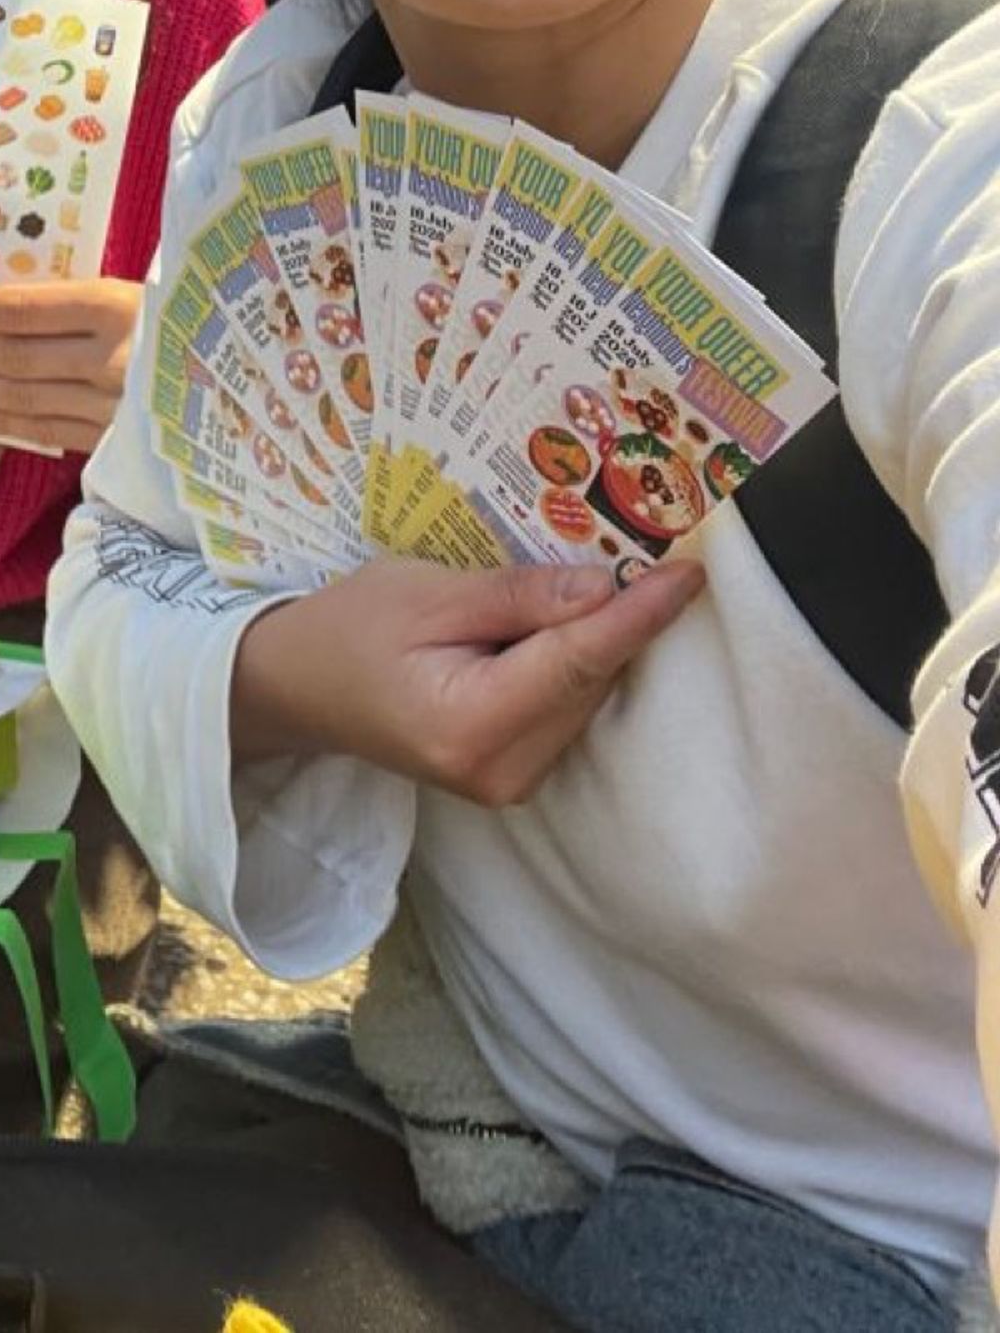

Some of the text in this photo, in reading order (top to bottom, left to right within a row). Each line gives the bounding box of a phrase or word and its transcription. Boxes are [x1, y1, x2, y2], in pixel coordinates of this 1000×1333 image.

[623, 337, 655, 368] July
[648, 256, 778, 398] YOUR QUEER
